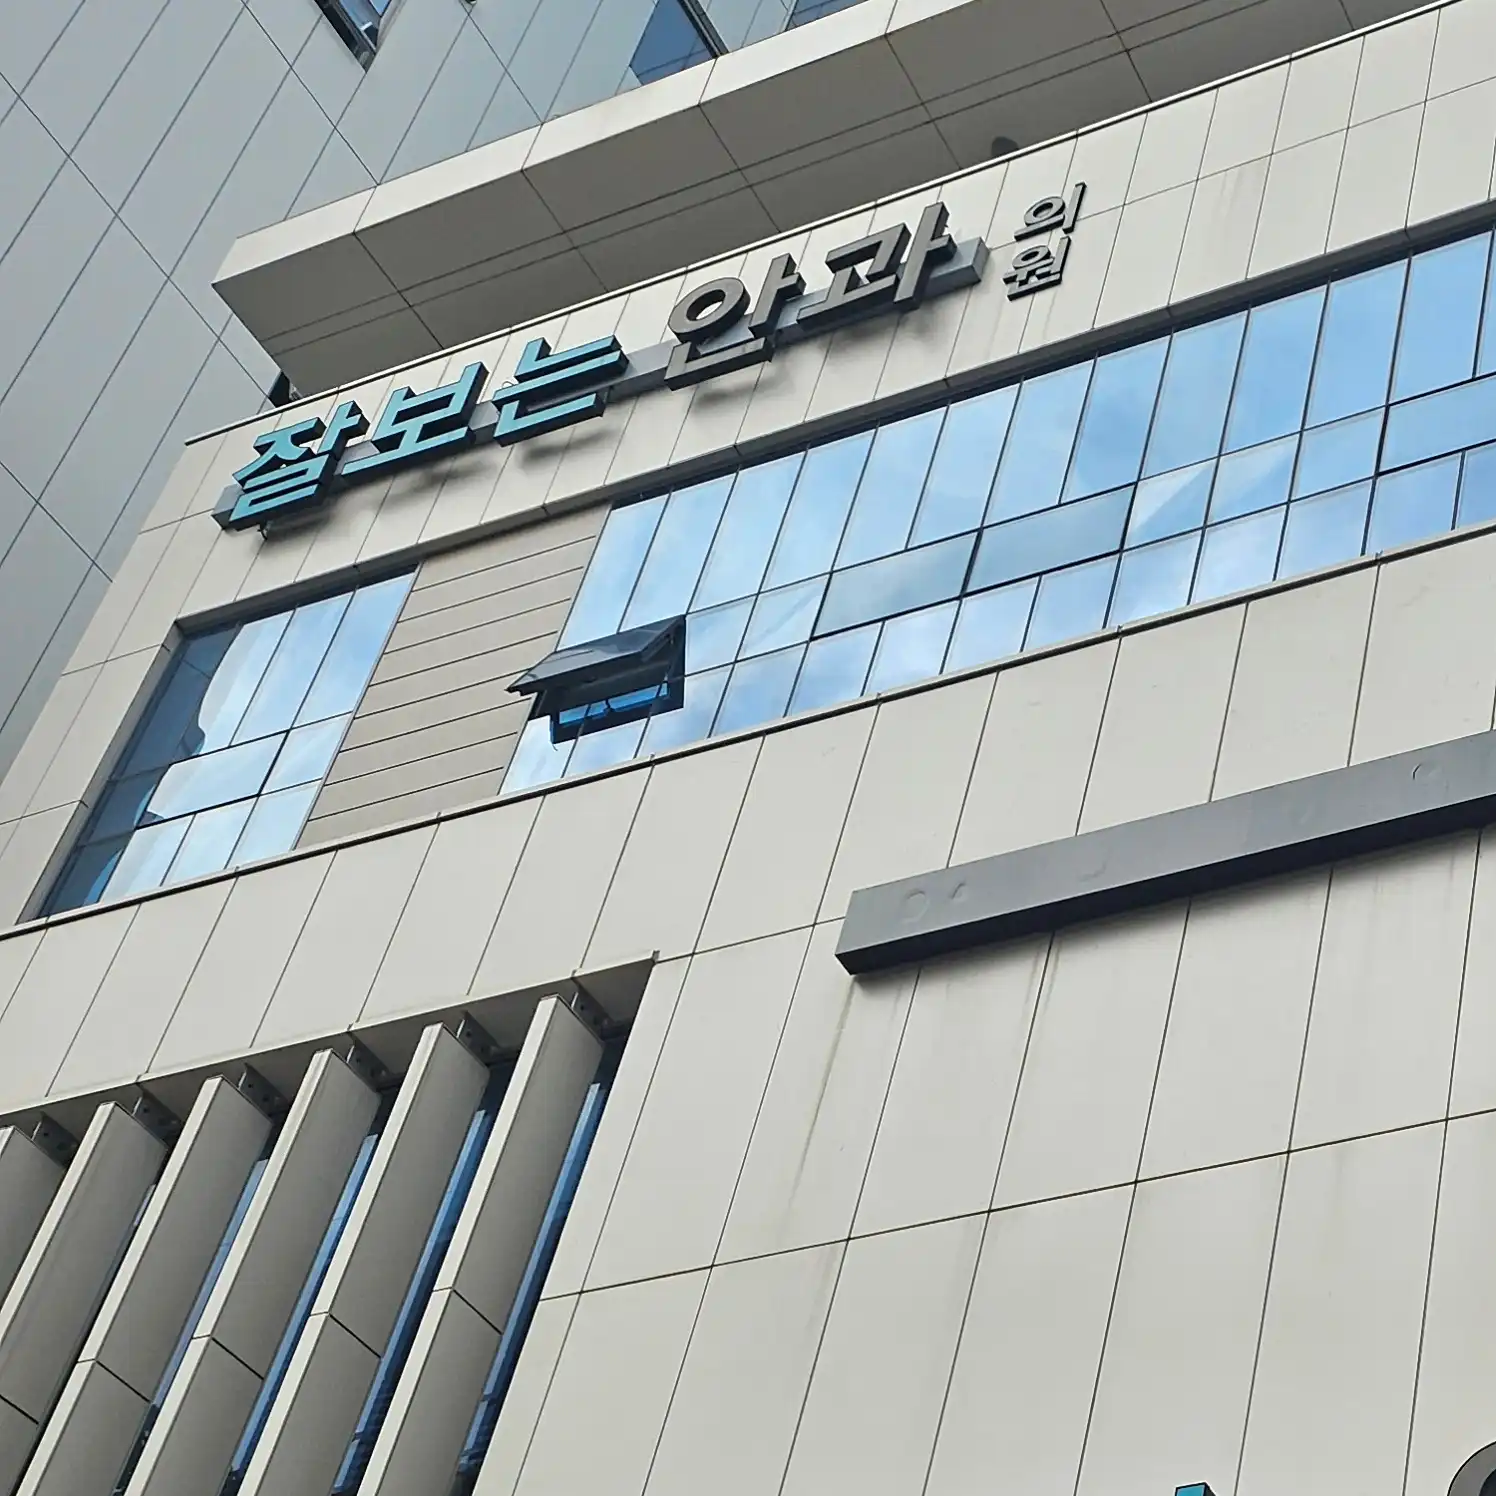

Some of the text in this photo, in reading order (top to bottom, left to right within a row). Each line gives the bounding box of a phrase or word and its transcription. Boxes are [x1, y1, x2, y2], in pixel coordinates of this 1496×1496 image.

[1002, 182, 1087, 300] 의원
[232, 202, 956, 529] 잘보는 안과
